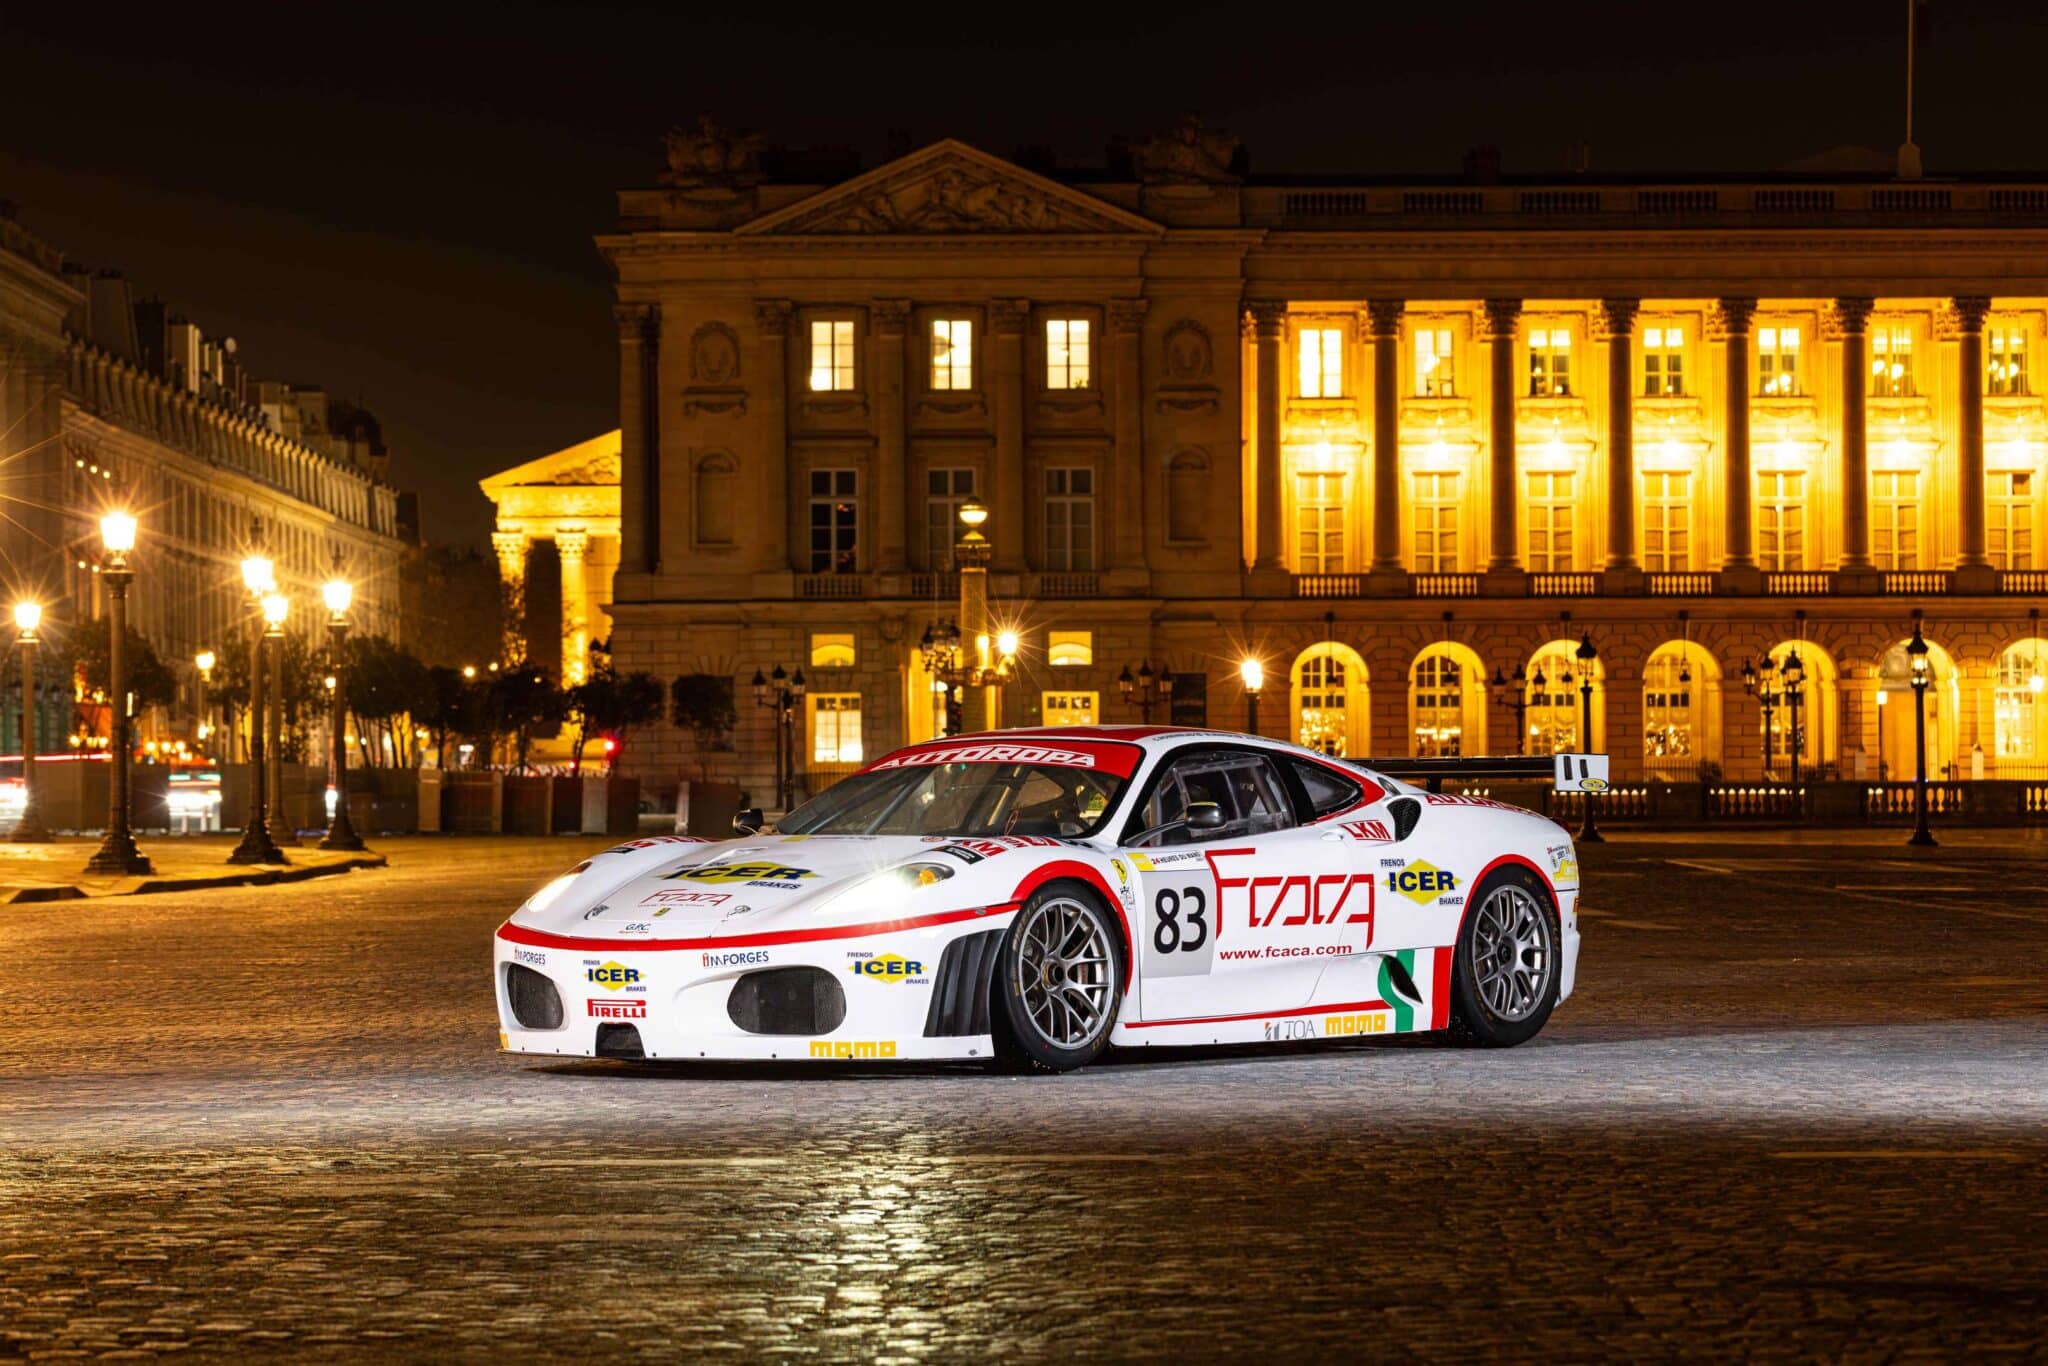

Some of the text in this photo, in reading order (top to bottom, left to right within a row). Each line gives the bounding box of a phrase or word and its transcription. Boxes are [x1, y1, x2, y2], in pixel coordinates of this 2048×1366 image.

[869, 745, 1095, 772] AUTOROPA
[1340, 820, 1393, 840] LKM
[1380, 858, 1406, 868] FRENOS
[662, 867, 803, 880] ICER
[1388, 871, 1456, 892] ICER
[745, 880, 802, 890] BRAKES
[1438, 896, 1464, 906] BRAKES
[1153, 886, 1208, 954] 83
[1219, 944, 1353, 961] www.fcaca.com
[587, 968, 640, 982] ICER
[854, 961, 923, 975] ICER
[625, 985, 647, 993] BRAKES
[587, 998, 647, 1018] PIRELLI
[1325, 1014, 1387, 1035] momo
[809, 1041, 897, 1058] momo
